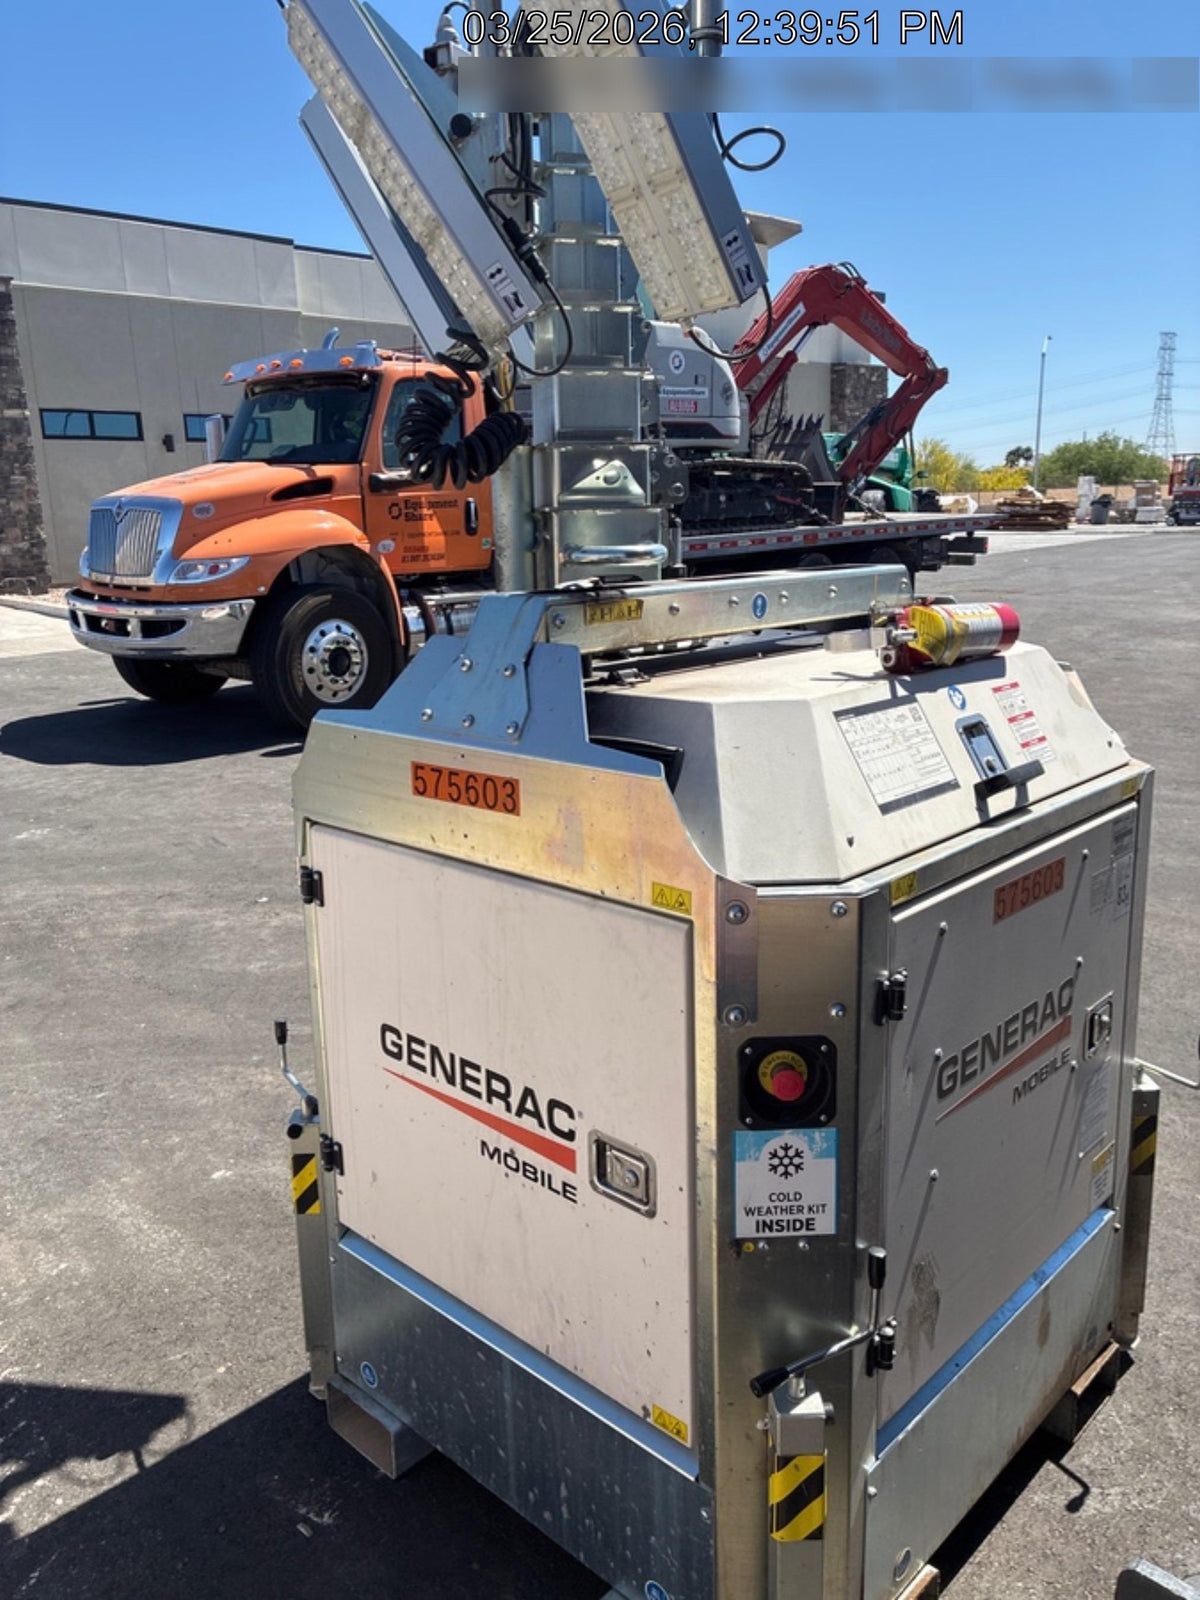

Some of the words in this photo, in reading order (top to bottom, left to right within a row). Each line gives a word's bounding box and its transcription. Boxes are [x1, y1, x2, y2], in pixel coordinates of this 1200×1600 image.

[413, 765, 517, 814] 575603
[996, 859, 1065, 920] 575603
[936, 976, 1075, 1101] GENERAC
[380, 1023, 576, 1143] GENERAC
[1012, 1046, 1072, 1106] MOBILE
[480, 1139, 578, 1204] MOBILE
[768, 1191, 803, 1203] COLD
[743, 1205, 804, 1218] WEATHER
[807, 1203, 828, 1215] KIT
[755, 1218, 816, 1234] INSIDE
